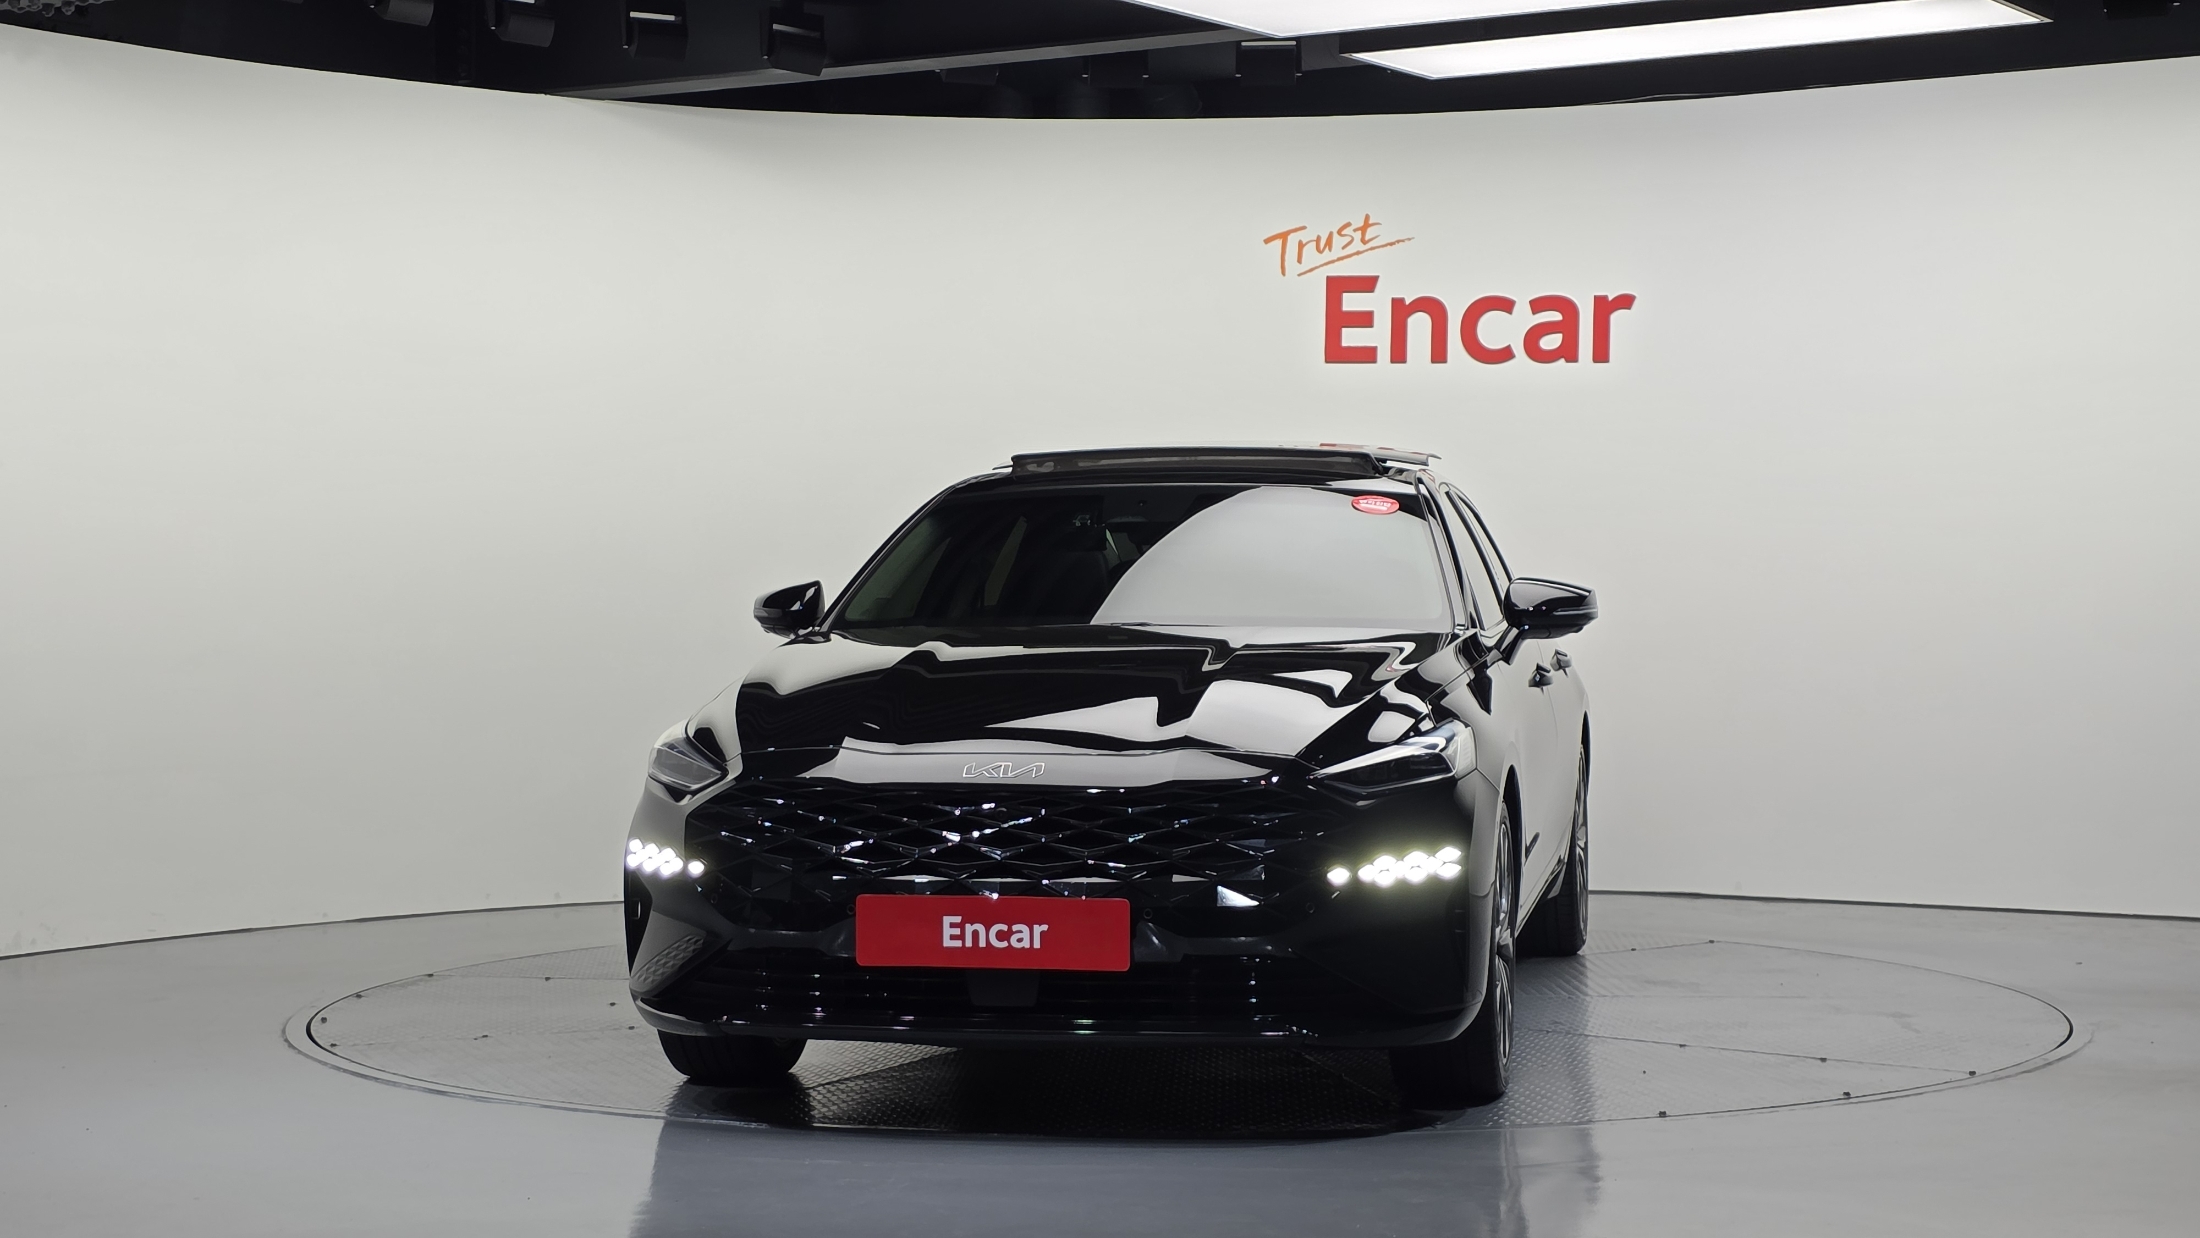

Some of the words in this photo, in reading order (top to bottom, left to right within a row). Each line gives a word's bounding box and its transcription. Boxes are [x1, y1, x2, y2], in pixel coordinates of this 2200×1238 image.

[1263, 213, 1384, 277] Trust
[1324, 275, 1637, 365] Encar
[942, 915, 1049, 949] Encar
